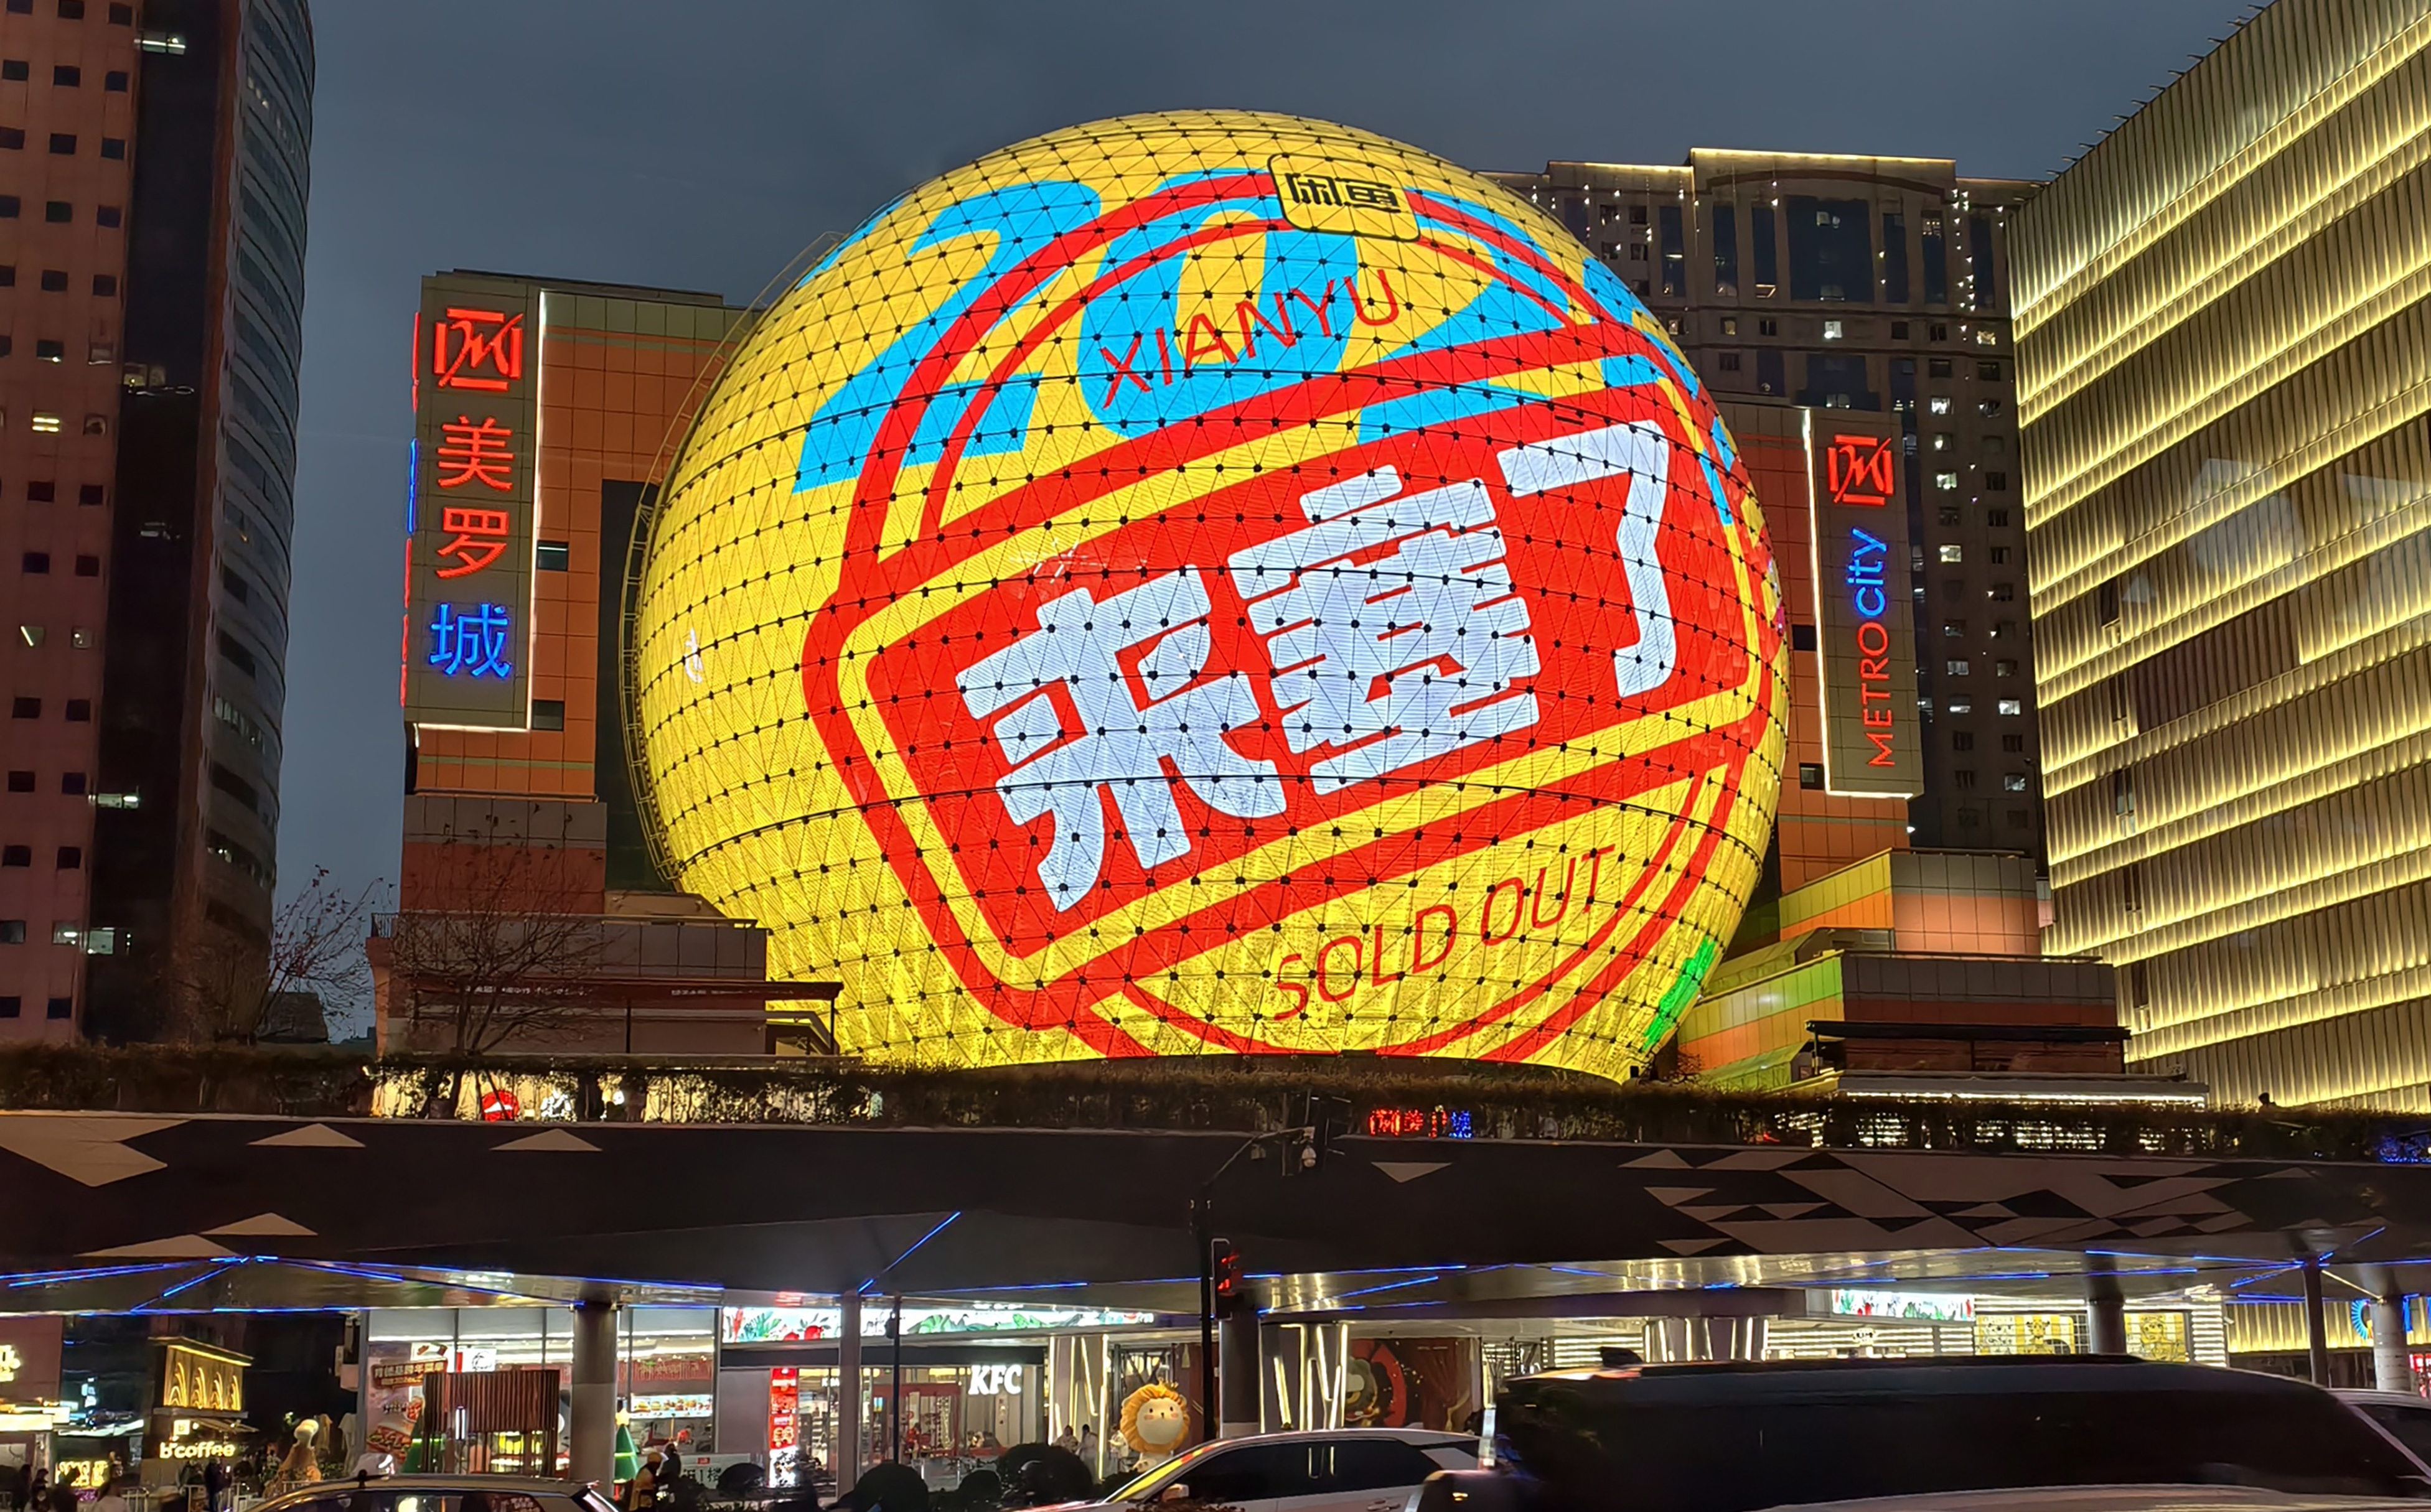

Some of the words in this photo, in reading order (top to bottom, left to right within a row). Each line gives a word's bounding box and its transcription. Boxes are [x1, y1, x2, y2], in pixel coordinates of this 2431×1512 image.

[1285, 172, 1401, 213] 闲鱼
[1100, 269, 1400, 409] XIANYU
[429, 416, 514, 679] 美罗城
[1274, 903, 1458, 1022] SOLD
[1481, 844, 1616, 946] OUT
[968, 1365, 1022, 1395] KFC
